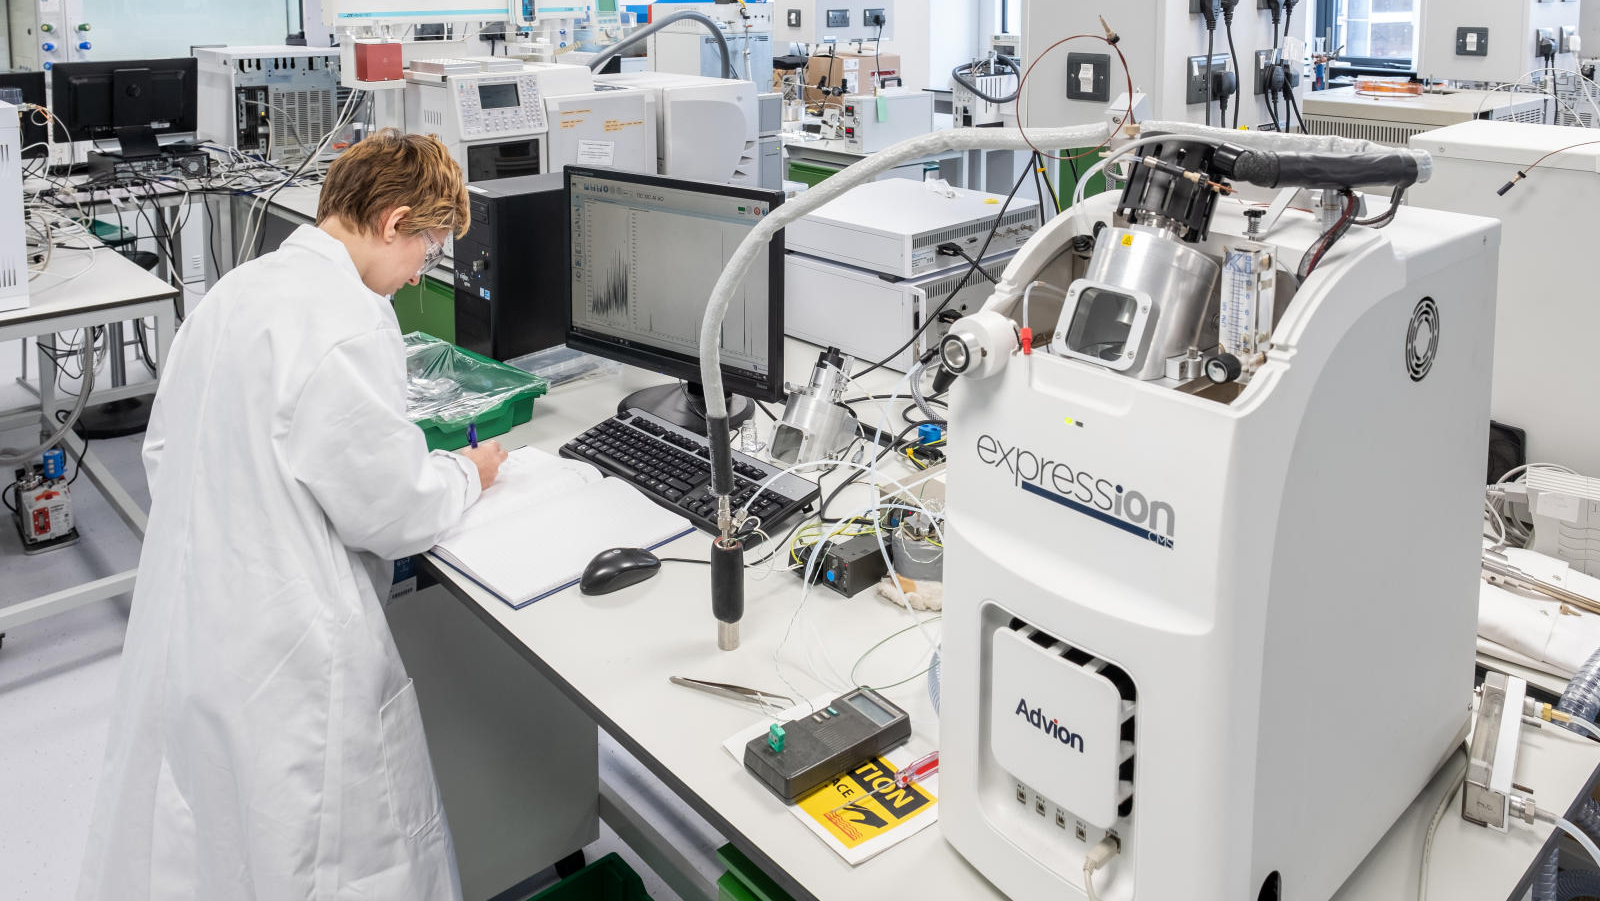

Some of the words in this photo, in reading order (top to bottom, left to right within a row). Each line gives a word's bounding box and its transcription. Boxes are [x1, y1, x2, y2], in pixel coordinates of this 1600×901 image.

[977, 434, 1175, 537] expression
[1148, 532, 1174, 550] CMS
[1015, 698, 1084, 753] Advion
[831, 777, 855, 798] ACE
[855, 762, 914, 808] TION
